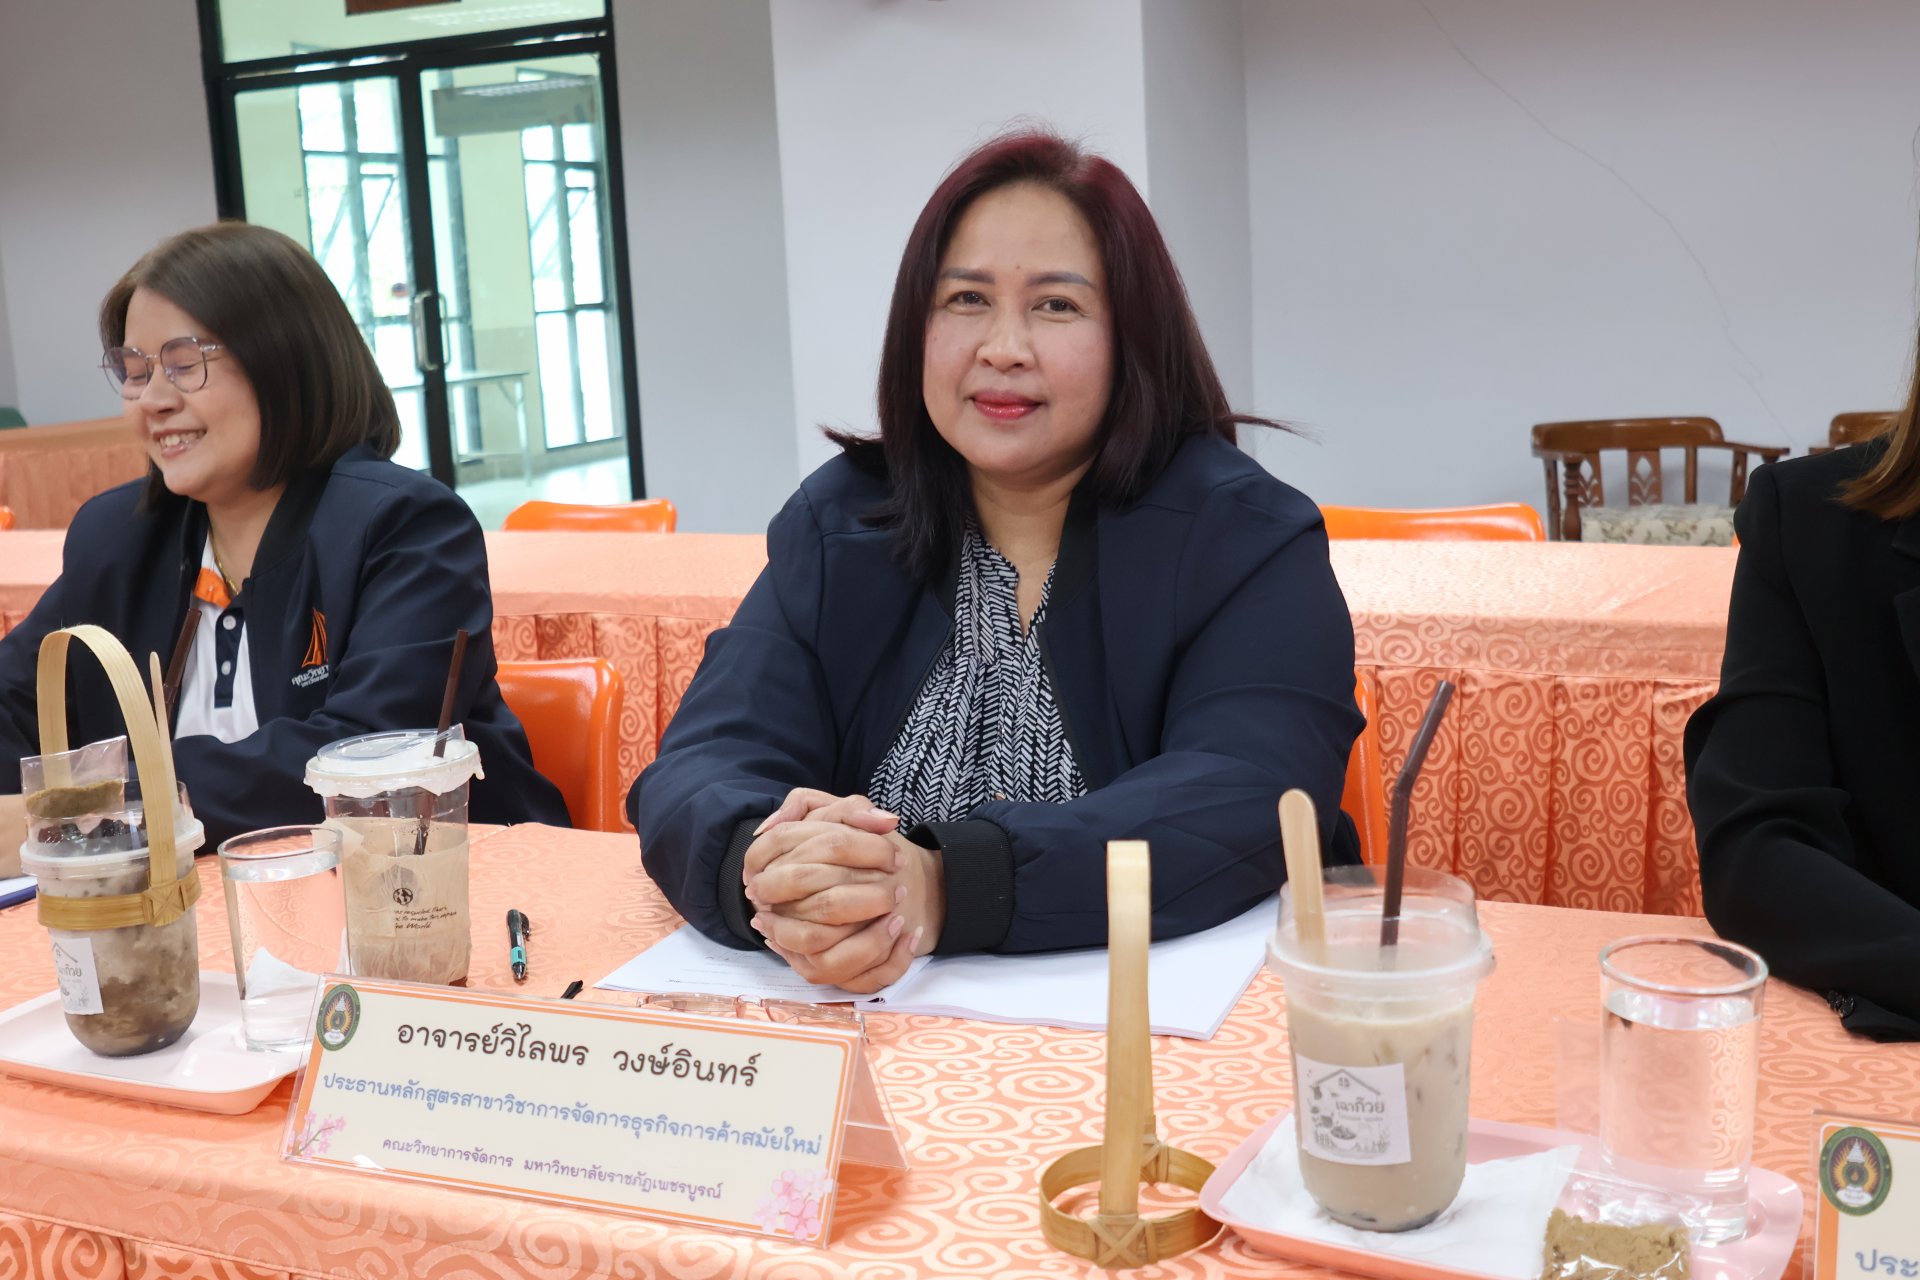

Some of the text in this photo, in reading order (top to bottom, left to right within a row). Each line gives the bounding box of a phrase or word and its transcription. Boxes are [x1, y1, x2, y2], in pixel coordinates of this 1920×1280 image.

[398, 1022, 762, 1087] อาจารย์วิไลพร วงษ์อินทร์
[323, 1072, 823, 1157] ประธานหลักสูตรสาขาวิชาการจัดการธุรกิจการค้าสมัยใหม่
[382, 1137, 723, 1203] คณะวิทยาการจัดการ มหาวิทยาลัยราชภัฏเพชรบูรณ์
